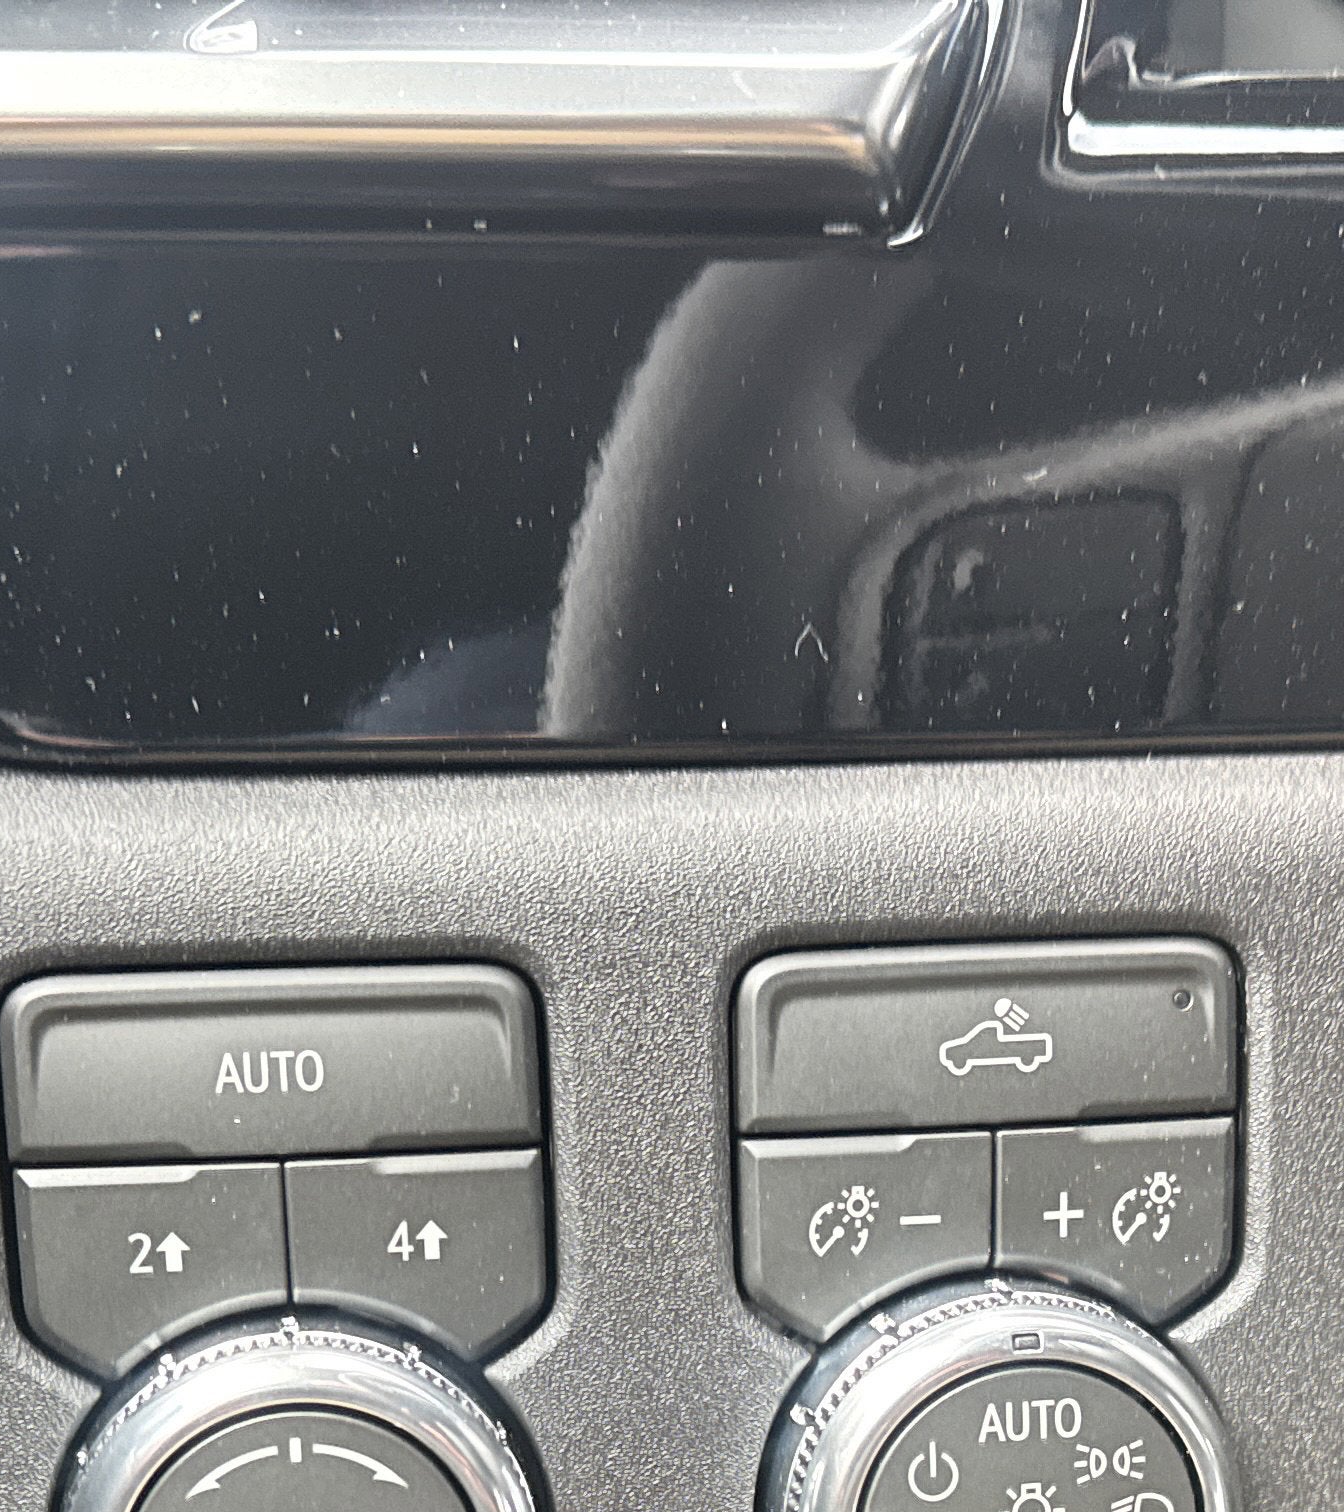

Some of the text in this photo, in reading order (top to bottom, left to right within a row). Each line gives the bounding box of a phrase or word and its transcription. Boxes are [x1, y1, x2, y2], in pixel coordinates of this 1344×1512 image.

[215, 1049, 324, 1094] AUTO
[127, 1232, 154, 1274] 2
[387, 1220, 415, 1262] 4
[978, 1397, 1082, 1444] AUTO
